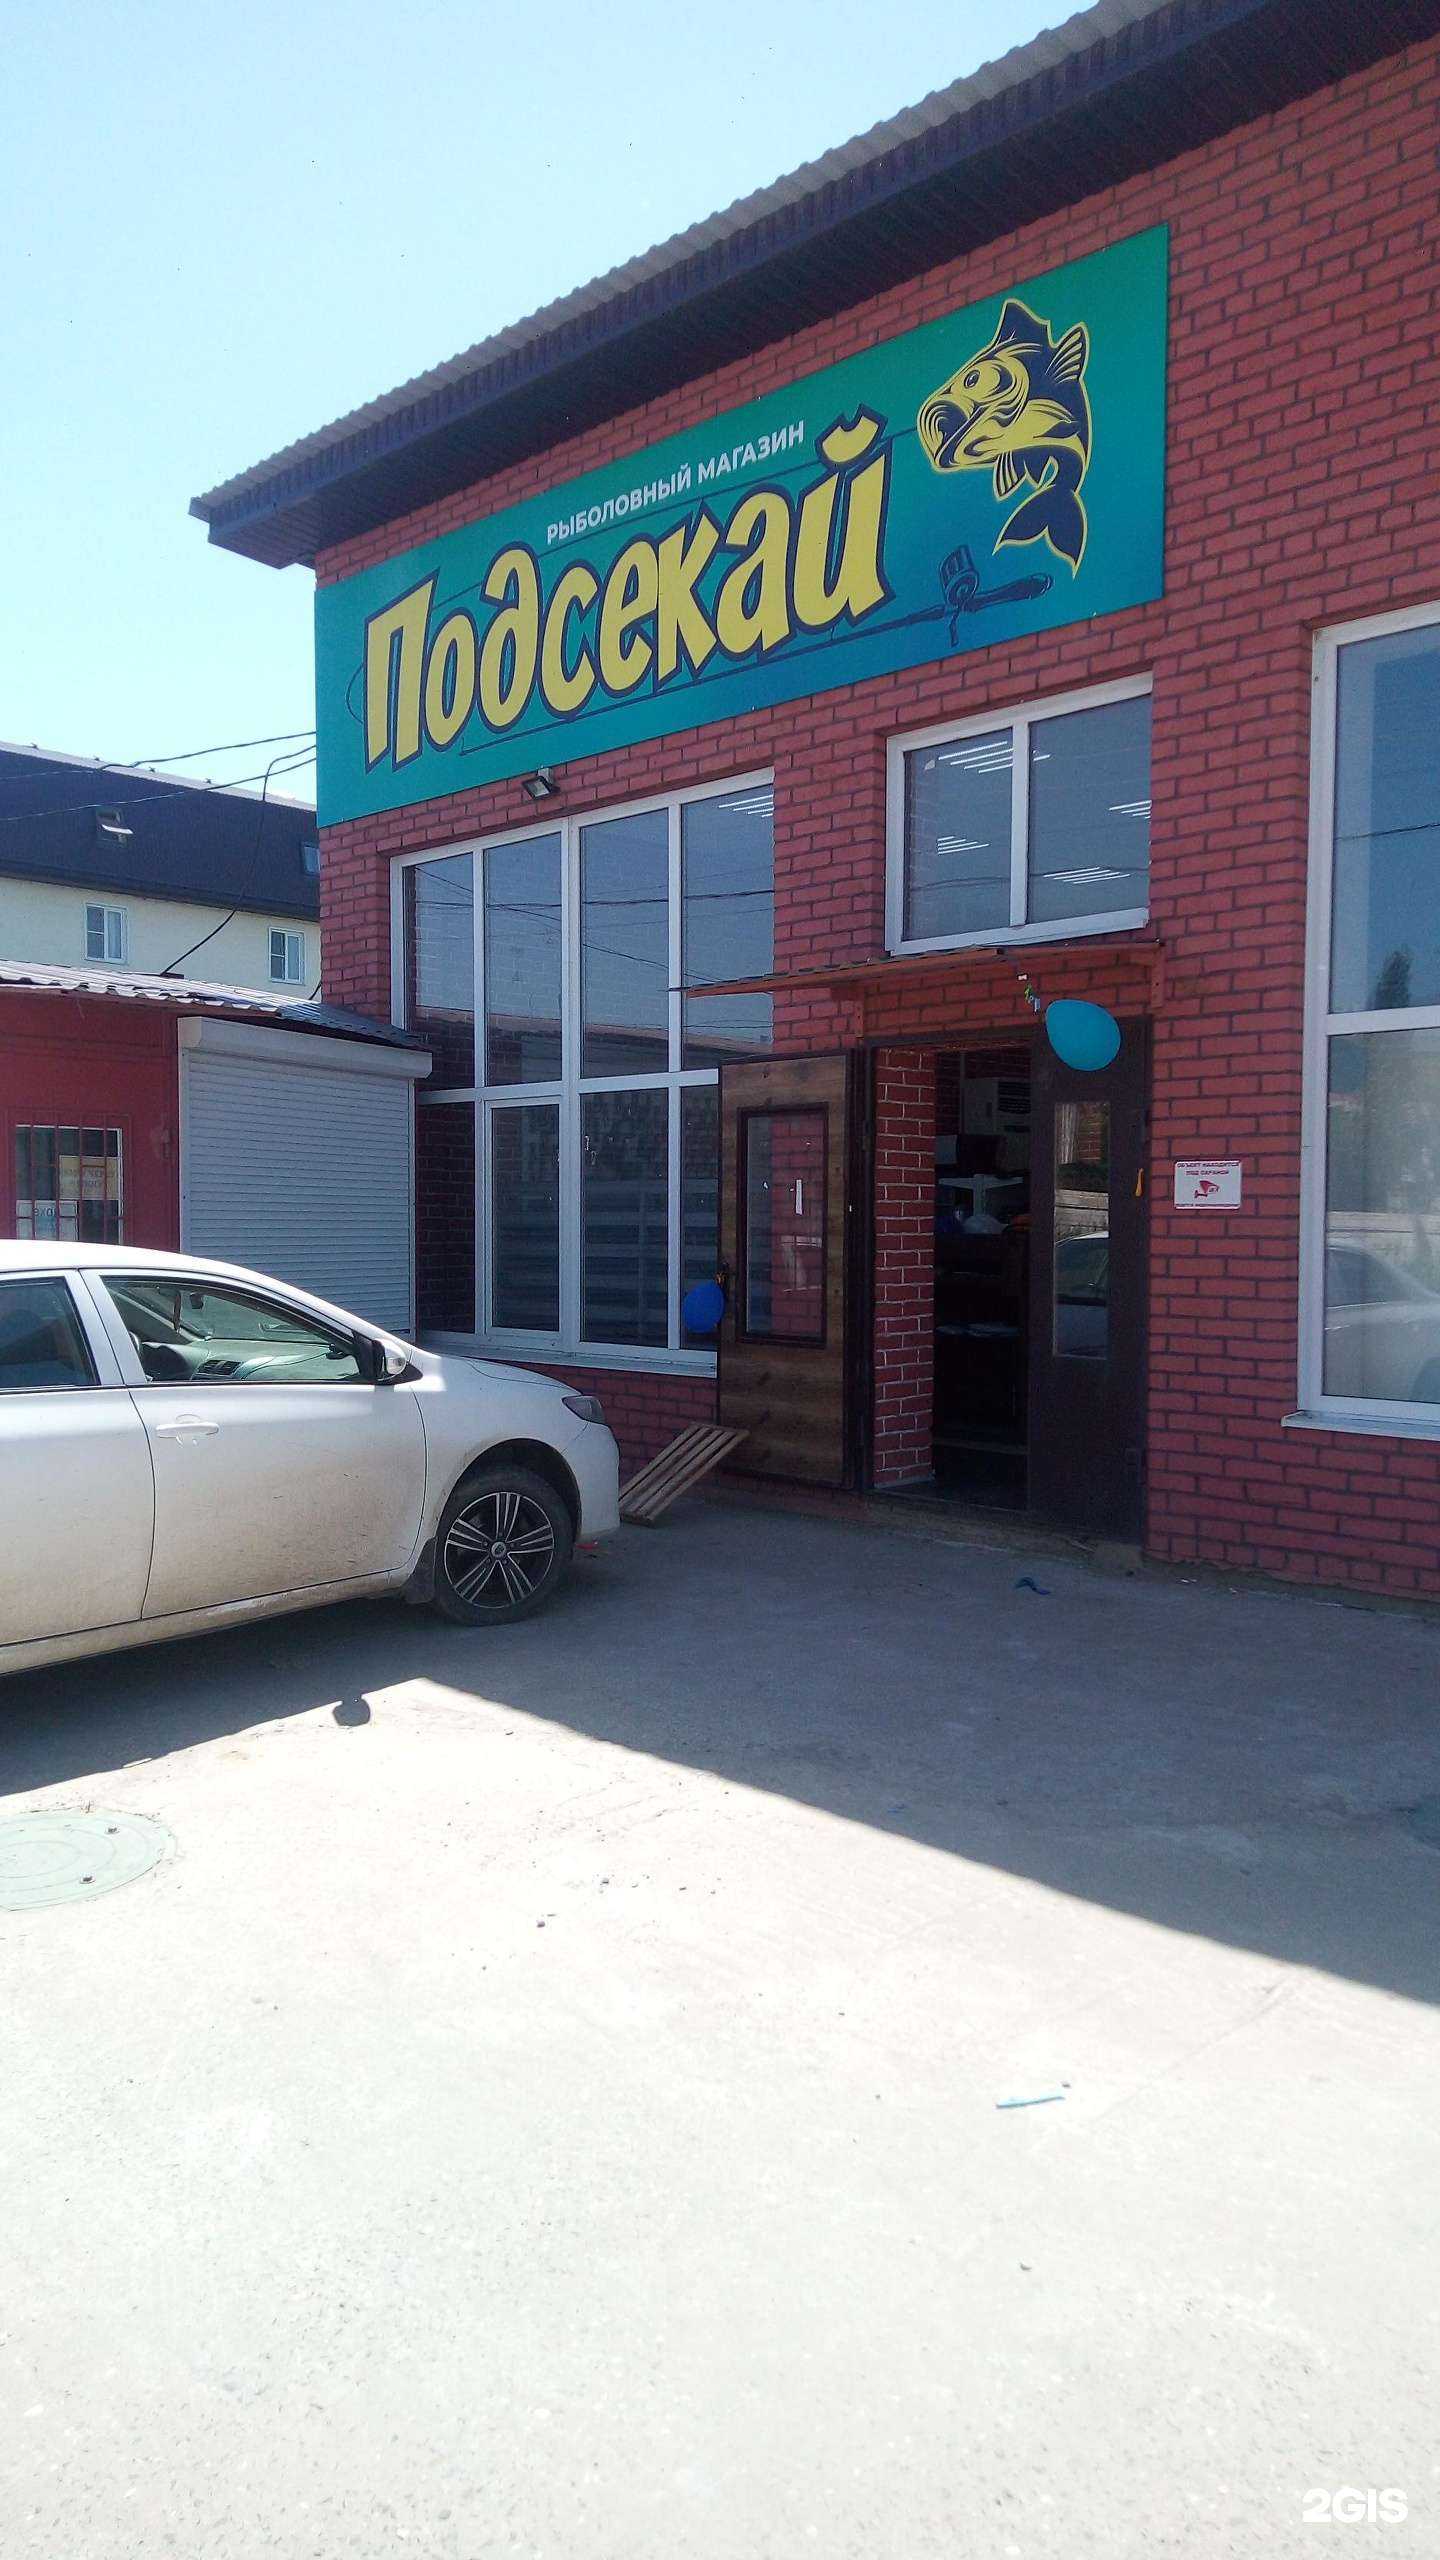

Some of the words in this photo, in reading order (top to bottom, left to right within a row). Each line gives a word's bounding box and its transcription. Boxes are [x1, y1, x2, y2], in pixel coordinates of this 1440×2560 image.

[365, 403, 896, 774] Подсекай
[547, 463, 692, 545] РЫБОЛОВНЫЙ
[697, 420, 805, 484] МАГАЗИН
